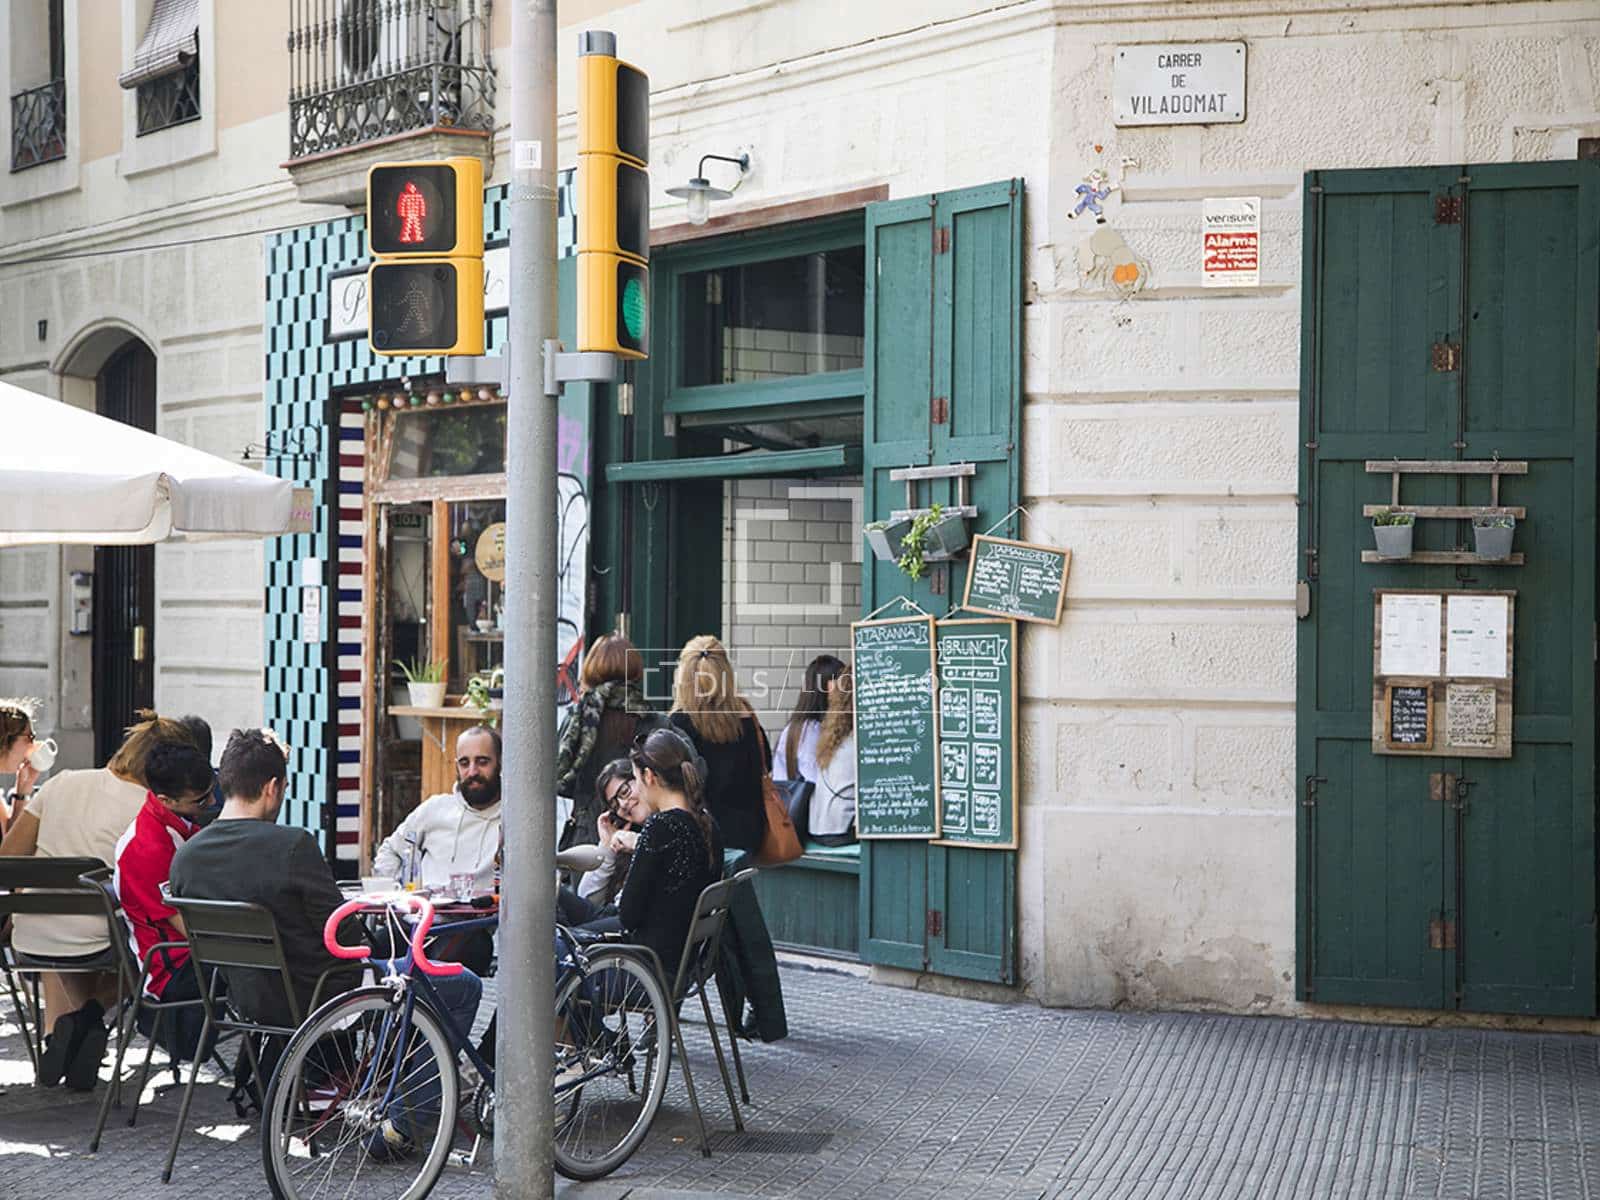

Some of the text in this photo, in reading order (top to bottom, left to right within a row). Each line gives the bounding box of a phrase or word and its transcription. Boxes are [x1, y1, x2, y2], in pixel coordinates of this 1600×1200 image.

[1158, 53, 1202, 69] CARRER
[1171, 74, 1187, 88] DE
[1130, 93, 1228, 115] VILADOMAT
[1206, 214, 1257, 224] verisure
[1206, 234, 1257, 248] Alarma
[944, 639, 996, 656] BRUNCH
